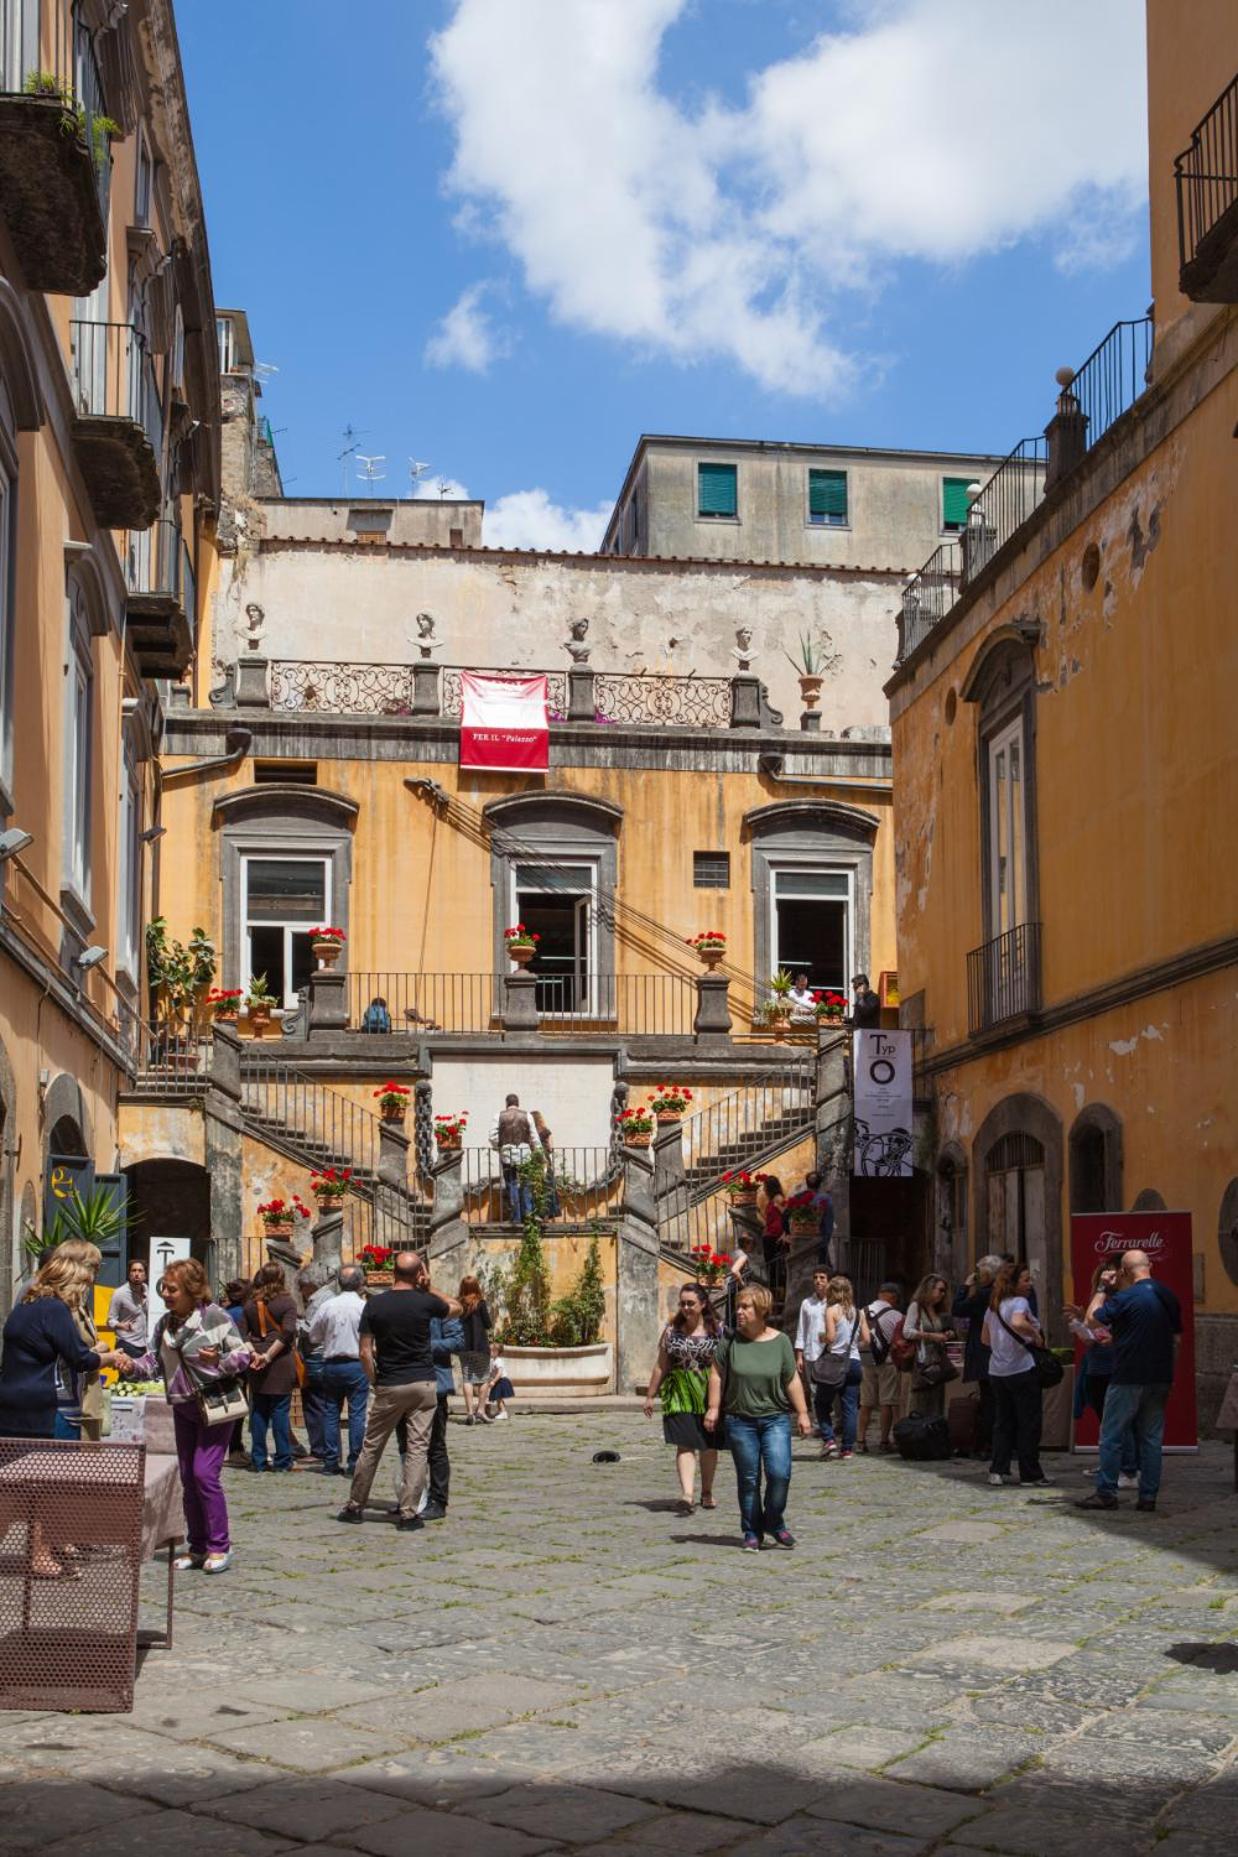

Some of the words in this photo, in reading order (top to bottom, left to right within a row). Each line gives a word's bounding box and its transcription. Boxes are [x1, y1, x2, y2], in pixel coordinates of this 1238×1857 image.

[473, 733, 489, 741] PER
[491, 733, 500, 741] IL
[869, 1034, 896, 1055] Typ
[1094, 1231, 1166, 1254] Ferrarelle
